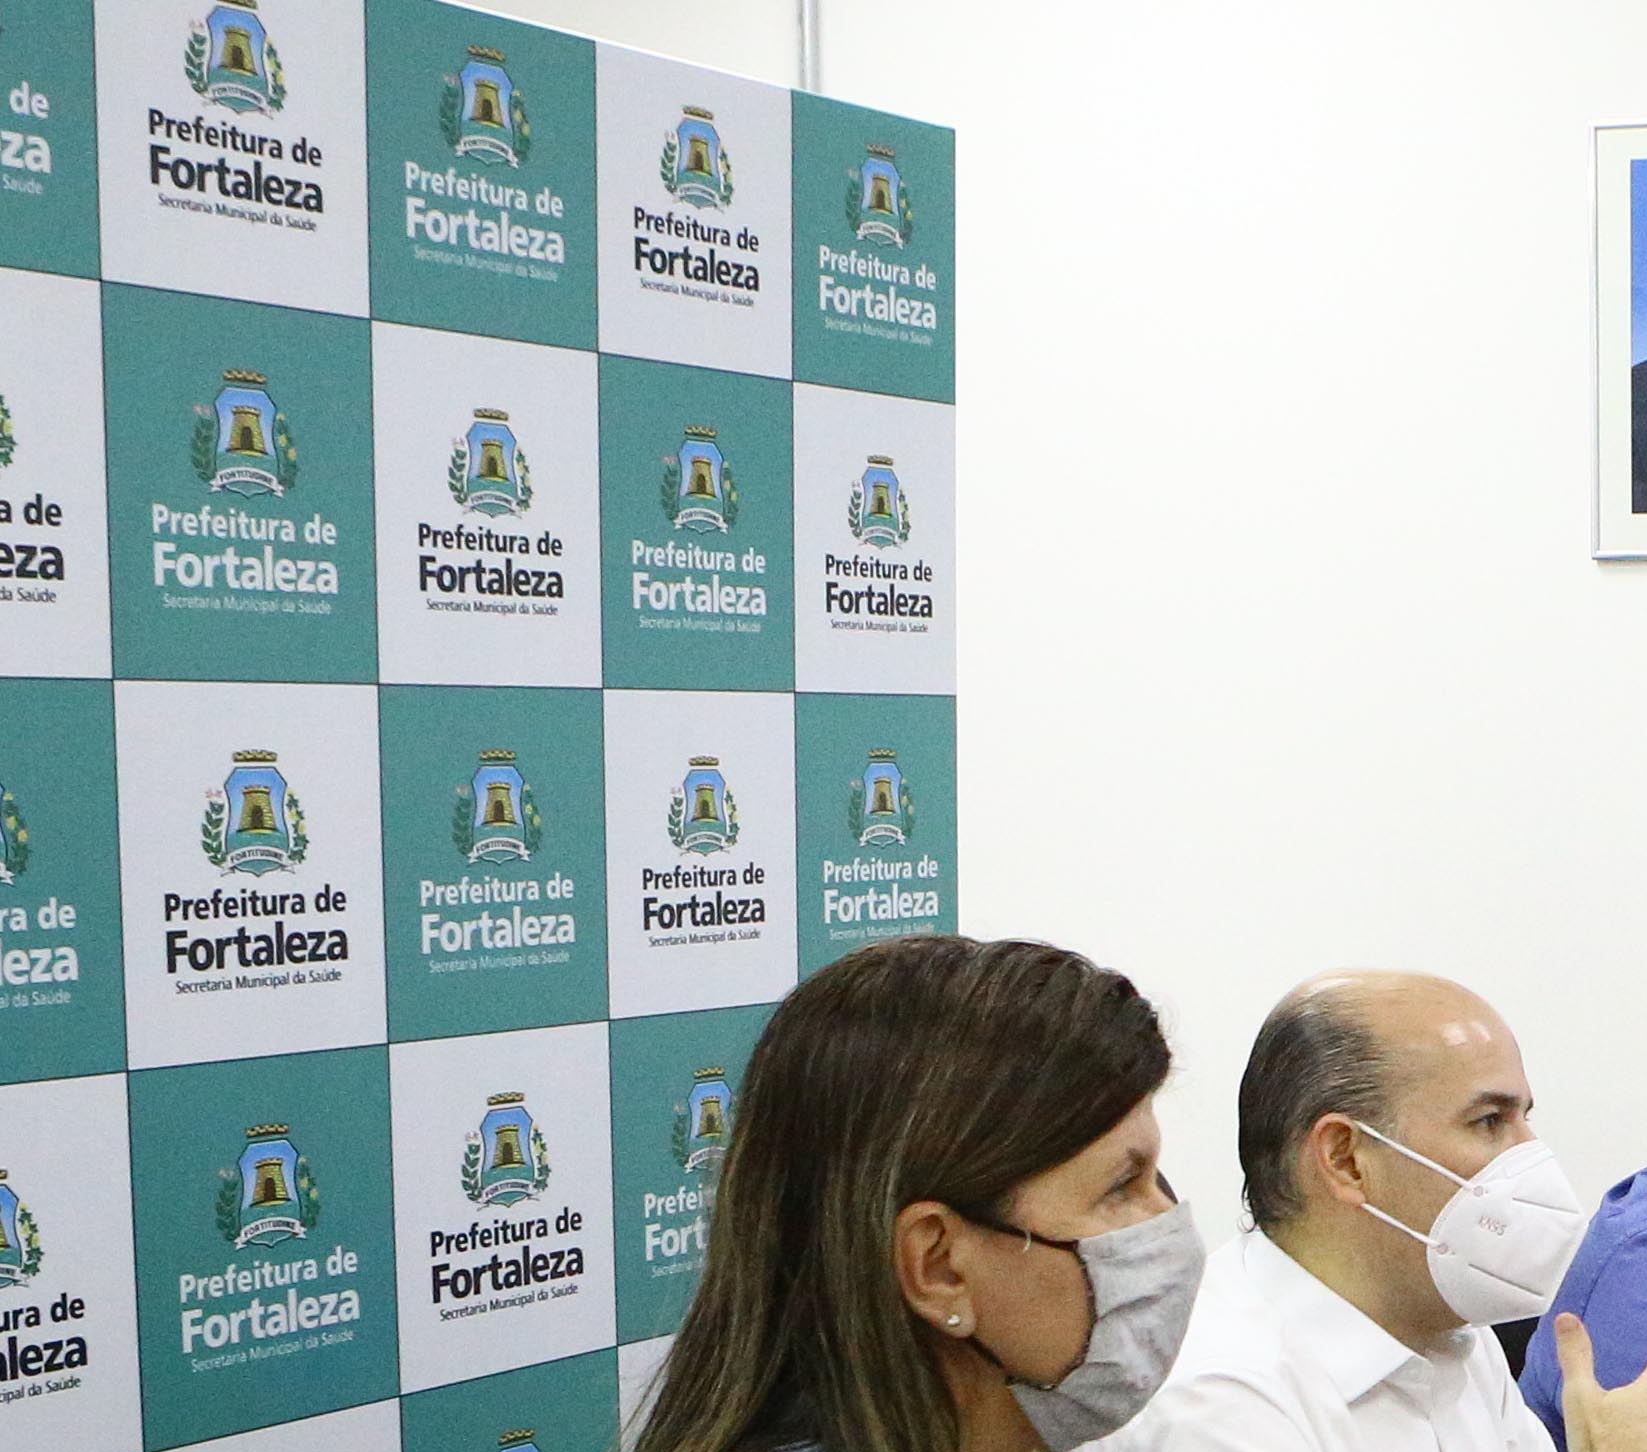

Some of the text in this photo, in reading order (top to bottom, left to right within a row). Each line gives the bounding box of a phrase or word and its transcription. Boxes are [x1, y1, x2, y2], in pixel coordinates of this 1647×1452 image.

[9, 80, 49, 119] de
[148, 108, 322, 168] Prefeitura de
[150, 143, 324, 214] Fortaleza
[405, 161, 564, 218] Prefeitura de
[270, 212, 283, 226] da
[406, 196, 564, 264] Fortaleza
[634, 206, 759, 253] Prefeitura de
[634, 236, 759, 292] Fortaleza
[819, 245, 936, 290] Prefeitura de
[820, 275, 936, 330] Fortaleza
[23, 493, 62, 526] de
[152, 504, 337, 545] Prefeitura de
[418, 523, 563, 557] Prefeitura de
[632, 540, 766, 574] Prefeitura de
[154, 542, 338, 594] Fortaleza
[419, 555, 564, 599] Fortaleza
[825, 554, 933, 582] Prefeitura de
[17, 586, 57, 603] Saúde
[426, 598, 558, 616] Secretaria Municipal da Saúde
[633, 572, 766, 615] Fortaleza
[825, 581, 933, 619] Fortaleza
[830, 618, 864, 631] Secretaria
[865, 620, 898, 634] Municipal
[642, 862, 765, 891] Prefeitura de
[823, 854, 938, 883] Prefeitura de
[164, 884, 347, 922] Prefeitura de
[420, 872, 574, 907] Prefeitura de
[824, 883, 939, 924] Fortaleza
[37, 897, 77, 930] de
[421, 906, 575, 954] Fortaleza
[643, 890, 765, 931] Fortaleza
[166, 921, 348, 974] Fortaleza
[649, 934, 688, 947] Secretaria
[688, 930, 726, 945] Municipal
[727, 930, 737, 941] da
[175, 968, 342, 995] Secretaria Municipal da Saúde
[644, 1184, 703, 1218] Prefei
[430, 1206, 582, 1258] Prefeitura de
[179, 1246, 358, 1303] Prefeitura de
[432, 1245, 584, 1304] Fortaleza
[50, 1292, 85, 1323] de
[181, 1288, 360, 1354] Fortaleza
[440, 1282, 579, 1322] Secretaria Municipal da Saúde
[28, 1383, 42, 1397] da
[45, 1376, 81, 1394] Saúde
